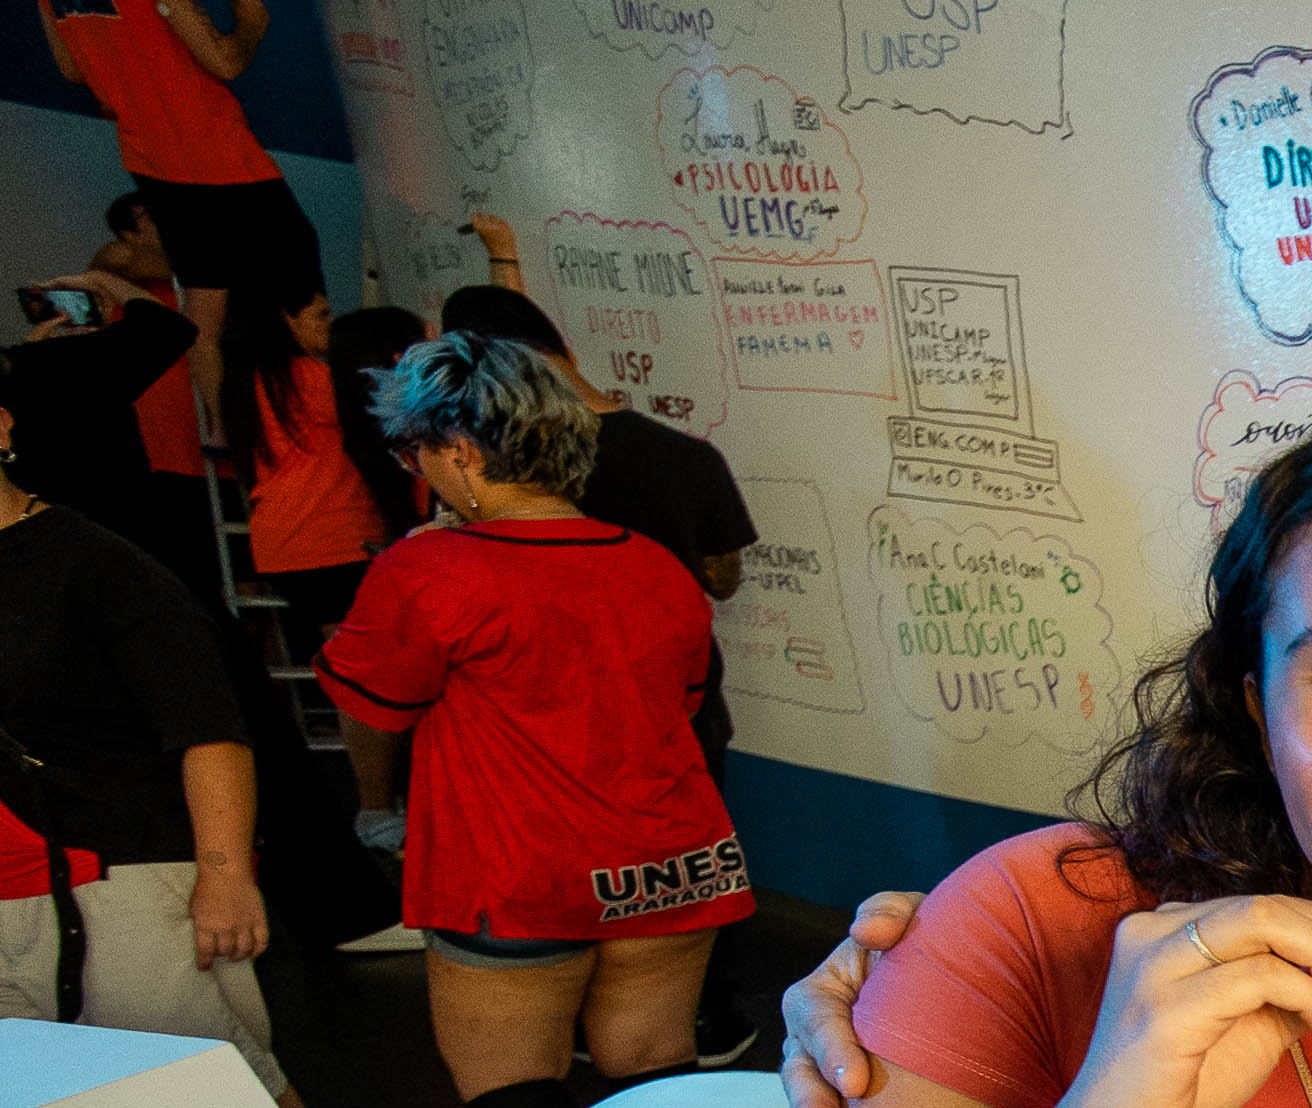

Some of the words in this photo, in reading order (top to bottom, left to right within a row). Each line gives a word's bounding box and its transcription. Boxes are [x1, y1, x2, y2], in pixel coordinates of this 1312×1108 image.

[862, 32, 961, 75] UNESP
[687, 159, 839, 196] PSICOLOGIA
[719, 195, 804, 238] UEMG
[721, 301, 879, 328] ENFERMAGEM
[610, 350, 654, 384] USP
[936, 663, 1060, 715] UNESP
